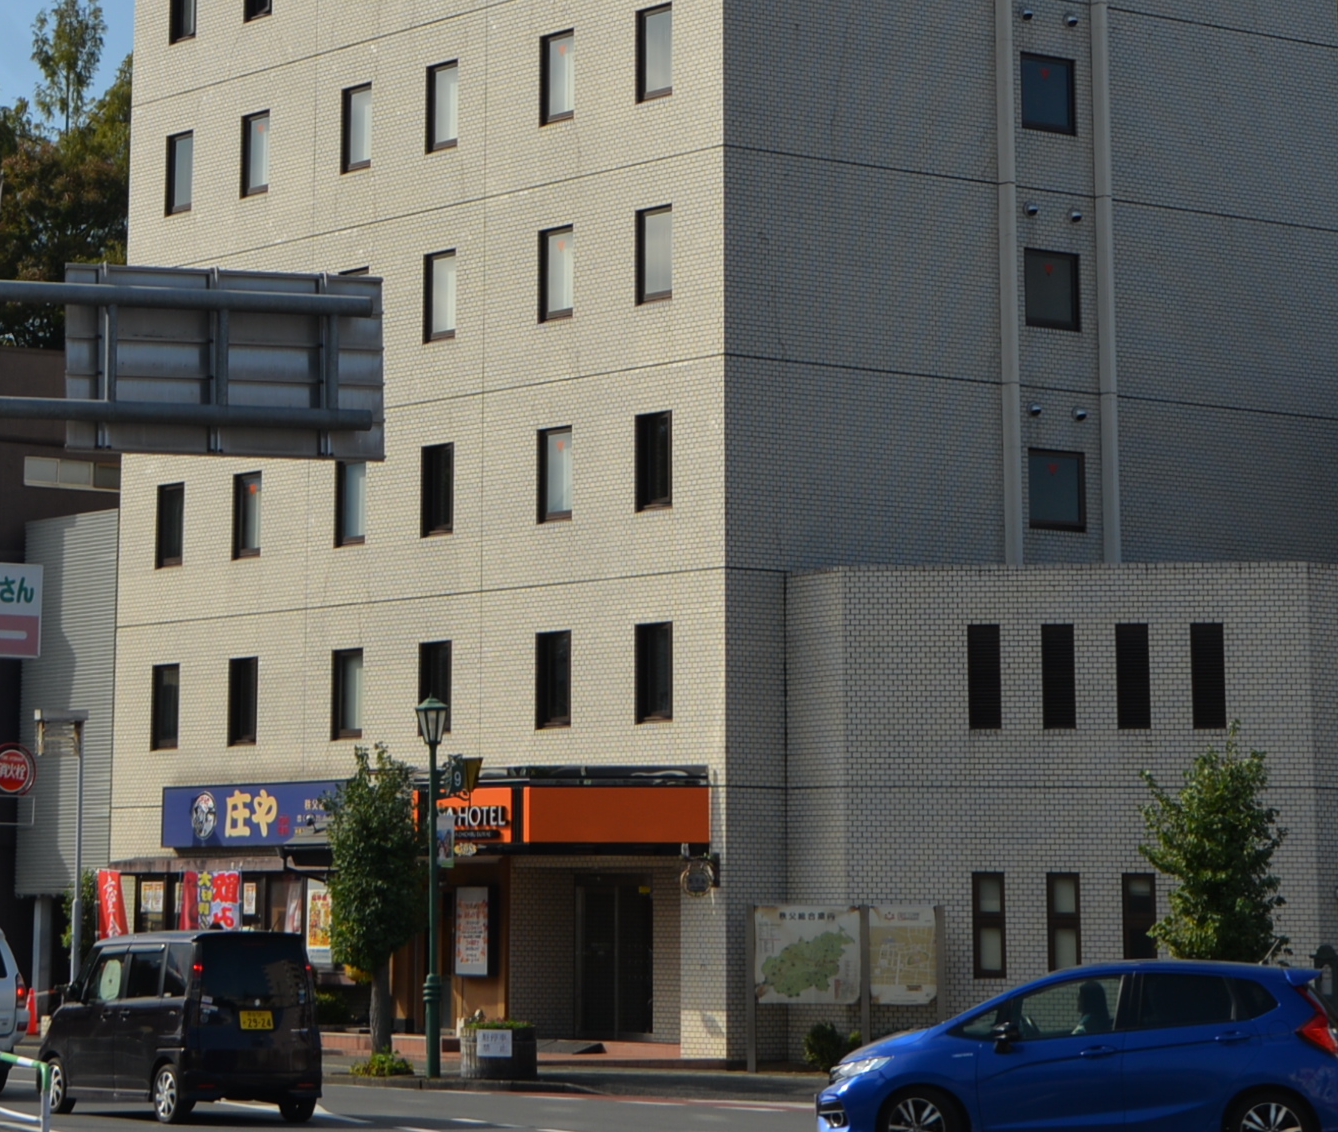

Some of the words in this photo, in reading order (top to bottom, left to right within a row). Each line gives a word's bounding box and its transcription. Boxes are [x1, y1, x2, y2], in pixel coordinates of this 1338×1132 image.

[454, 771, 461, 786] 9
[224, 789, 278, 838] 庄や
[458, 805, 506, 826] HOTEL
